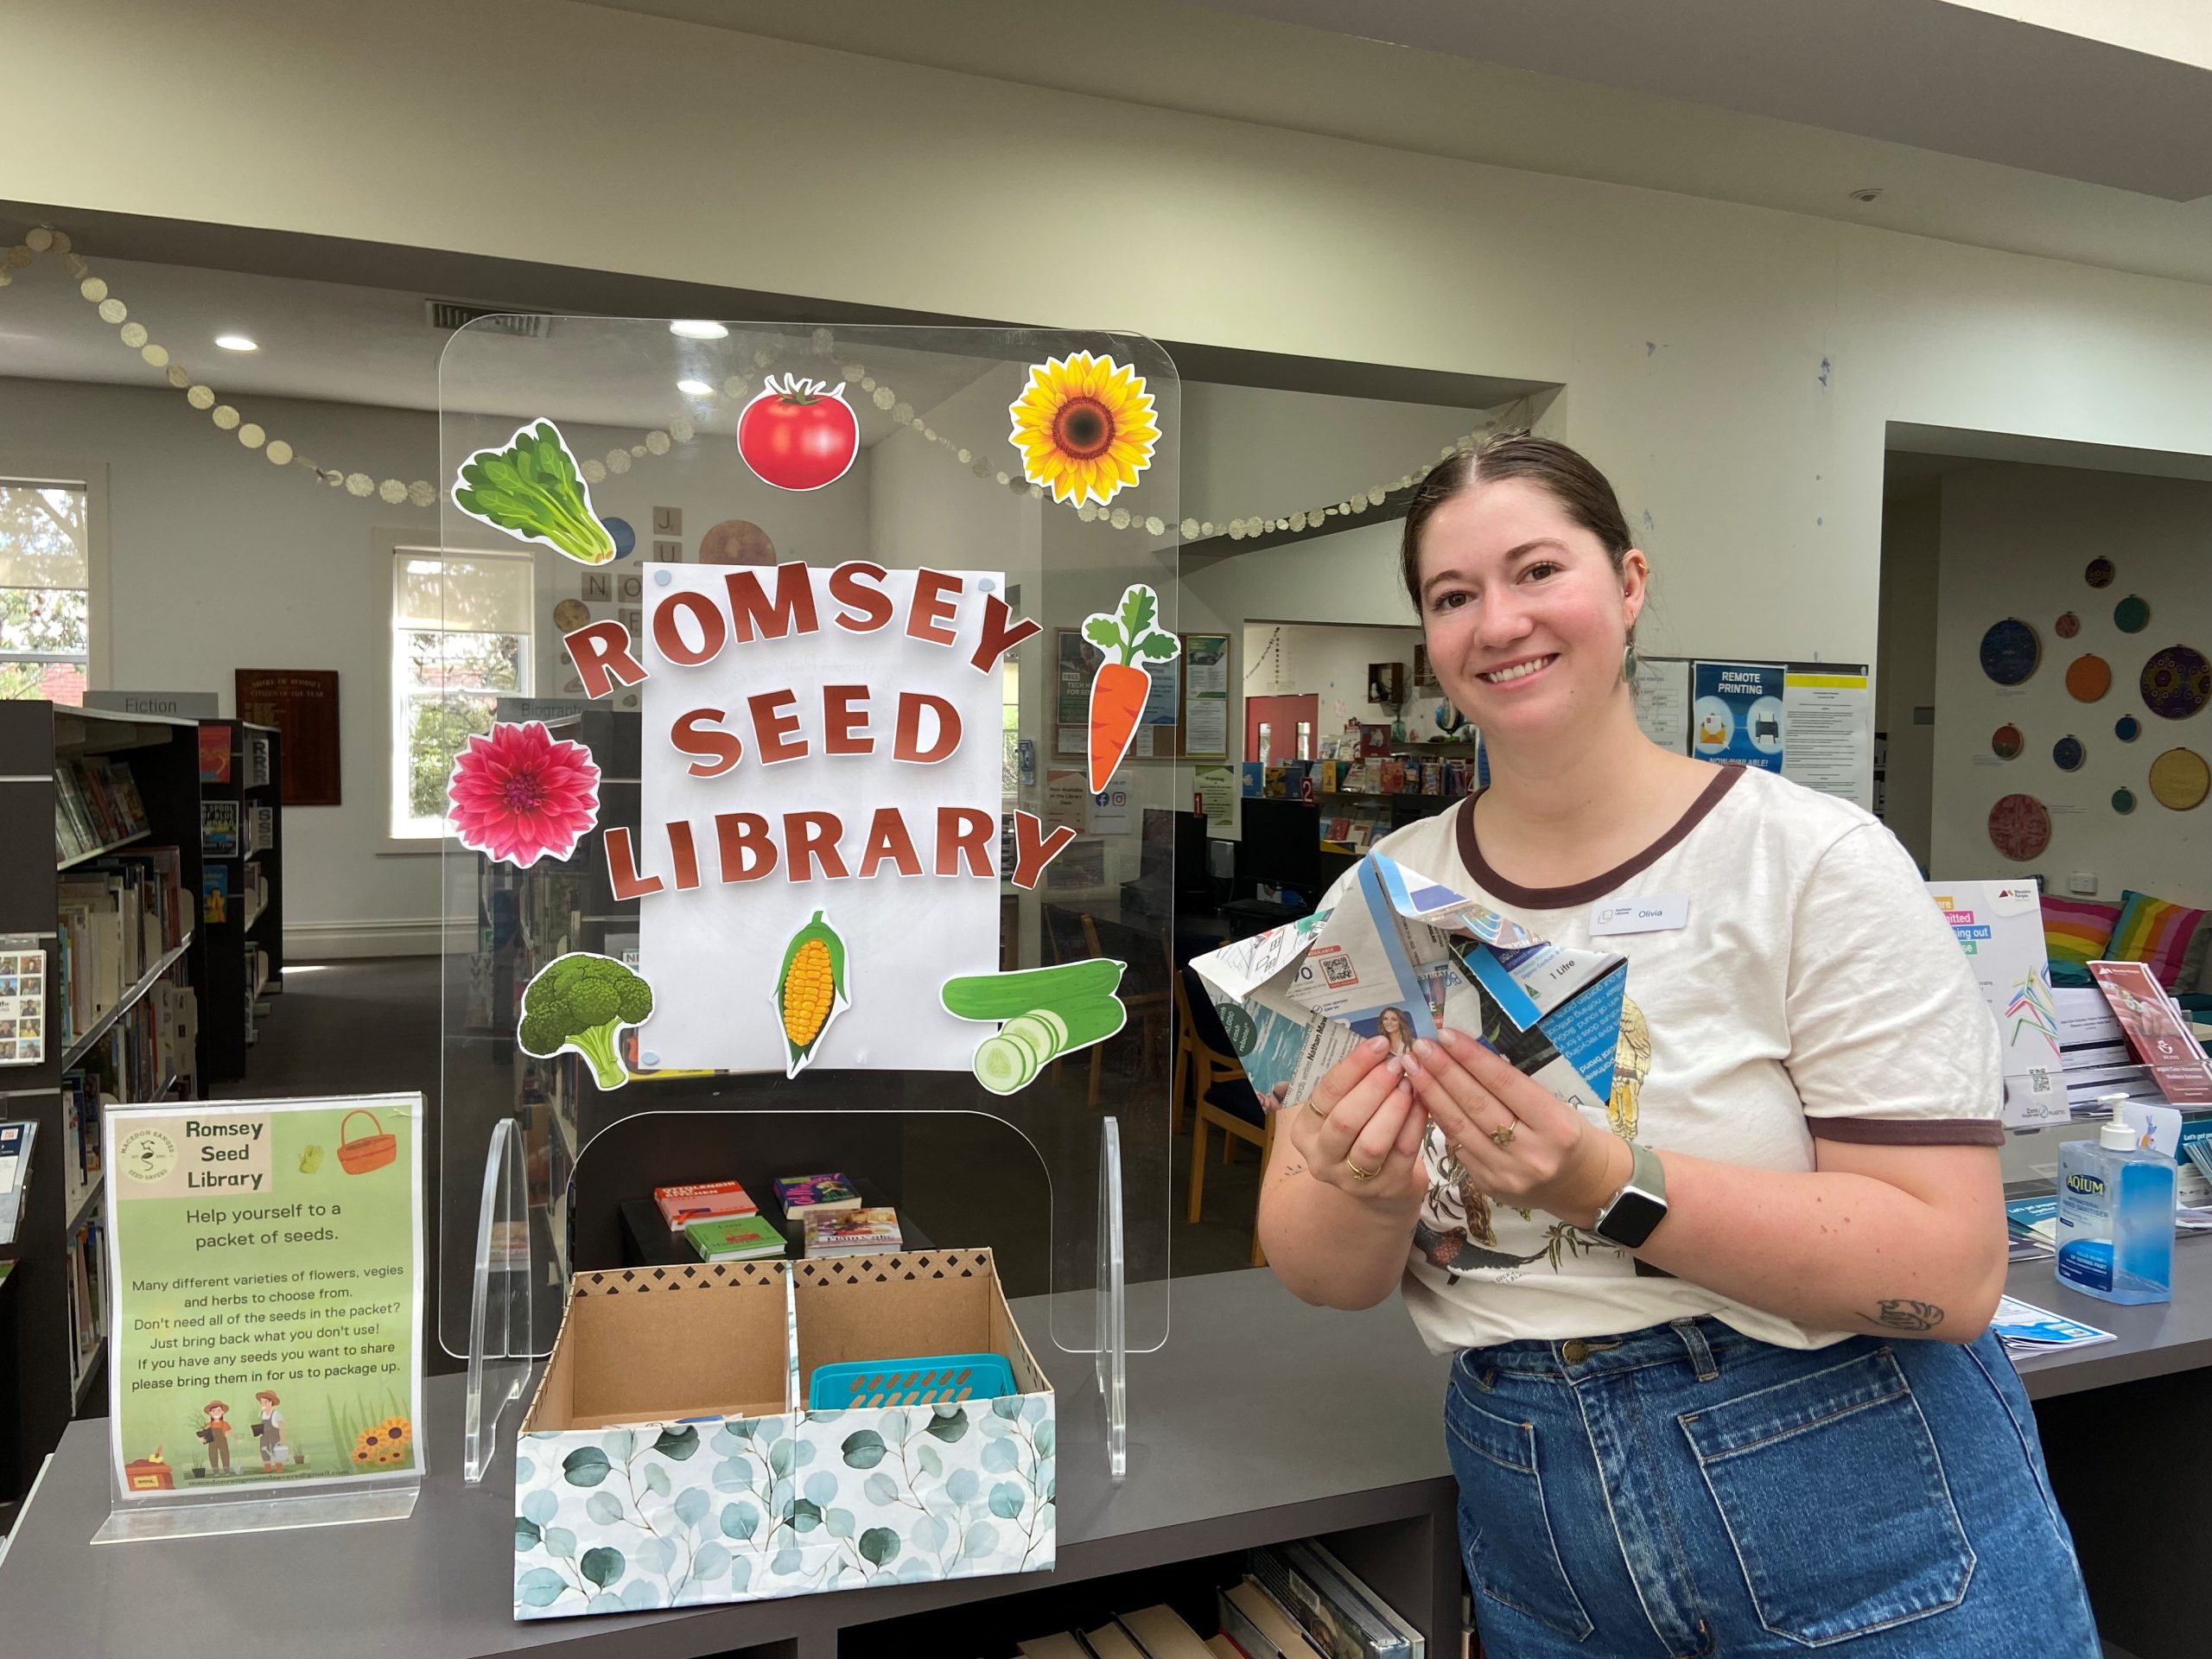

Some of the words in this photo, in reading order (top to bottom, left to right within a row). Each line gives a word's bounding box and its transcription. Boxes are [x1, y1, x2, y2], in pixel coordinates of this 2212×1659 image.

[563, 560, 1043, 699] ROMSEY
[1722, 671, 1761, 683] REMOTE
[1718, 683, 1763, 695] PRINTING
[124, 697, 177, 713] Fiction
[671, 684, 963, 779] SEED
[1710, 757, 1728, 766] NOW
[1729, 758, 1769, 767] AVAILABLE!
[1302, 780, 1313, 804] 2
[1195, 795, 1200, 814] 1
[603, 806, 1077, 901] LIBRARY
[1638, 910, 1662, 918] Olivia
[1974, 927, 1989, 938] out
[1555, 958, 1575, 975] Litre
[1573, 982, 1604, 1005] garden
[1217, 1005, 1227, 1020] with
[1573, 995, 1602, 1019] nothing
[1230, 1023, 1241, 1041] cash
[1580, 1022, 1600, 1038] does
[1597, 1023, 1614, 1038] love
[1564, 1033, 1599, 1059] recycling
[1295, 1080, 1306, 1100] words
[1306, 1033, 1322, 1061] Nathan
[1578, 1054, 1602, 1073] brand
[186, 1121, 264, 1140] Romsey
[121, 1130, 151, 1154] MACEDON
[200, 1144, 250, 1161] Seed
[129, 1169, 144, 1179] SEED
[188, 1170, 264, 1190] Library
[187, 1209, 226, 1225] Help
[232, 1204, 302, 1224] yourself
[307, 1203, 327, 1216] to
[331, 1205, 341, 1216] a
[195, 1233, 255, 1251] packet
[260, 1230, 279, 1244] of
[283, 1227, 339, 1243] seeds.
[131, 1281, 168, 1293] Many
[172, 1277, 230, 1290] different
[232, 1272, 288, 1286] varieties
[291, 1270, 305, 1282] of
[308, 1267, 360, 1281] flowers,
[363, 1264, 404, 1278] vegies
[184, 1295, 207, 1308] and
[212, 1294, 248, 1306] herbs
[251, 1293, 265, 1304] to
[269, 1290, 315, 1303] choose
[319, 1287, 353, 1300] from.
[134, 1318, 169, 1331] Don't
[173, 1315, 206, 1328] need
[208, 1313, 223, 1325] all
[226, 1313, 241, 1325] of
[244, 1312, 265, 1324] the
[269, 1308, 306, 1322] seeds
[309, 1307, 321, 1319] in
[324, 1306, 346, 1319] the
[349, 1301, 401, 1318] packet?
[149, 1338, 178, 1350] Just
[181, 1335, 215, 1349] bring
[219, 1332, 251, 1345] back
[253, 1331, 286, 1344] what
[289, 1331, 313, 1343] you
[316, 1325, 350, 1339] don't
[353, 1323, 380, 1336] use!
[137, 1358, 147, 1370] If
[150, 1358, 175, 1371] you
[178, 1355, 210, 1368] have
[213, 1354, 237, 1367] any
[240, 1351, 277, 1363] seeds
[281, 1349, 305, 1362] you
[308, 1346, 340, 1358] want
[343, 1344, 357, 1356] to
[359, 1342, 395, 1355] share
[131, 1377, 173, 1393] please
[176, 1375, 210, 1389] bring
[213, 1372, 248, 1384] them
[251, 1370, 263, 1382] in
[266, 1369, 285, 1381] for
[289, 1368, 303, 1379] us
[307, 1366, 321, 1377] to
[324, 1363, 377, 1379] package
[380, 1360, 401, 1374] up.
